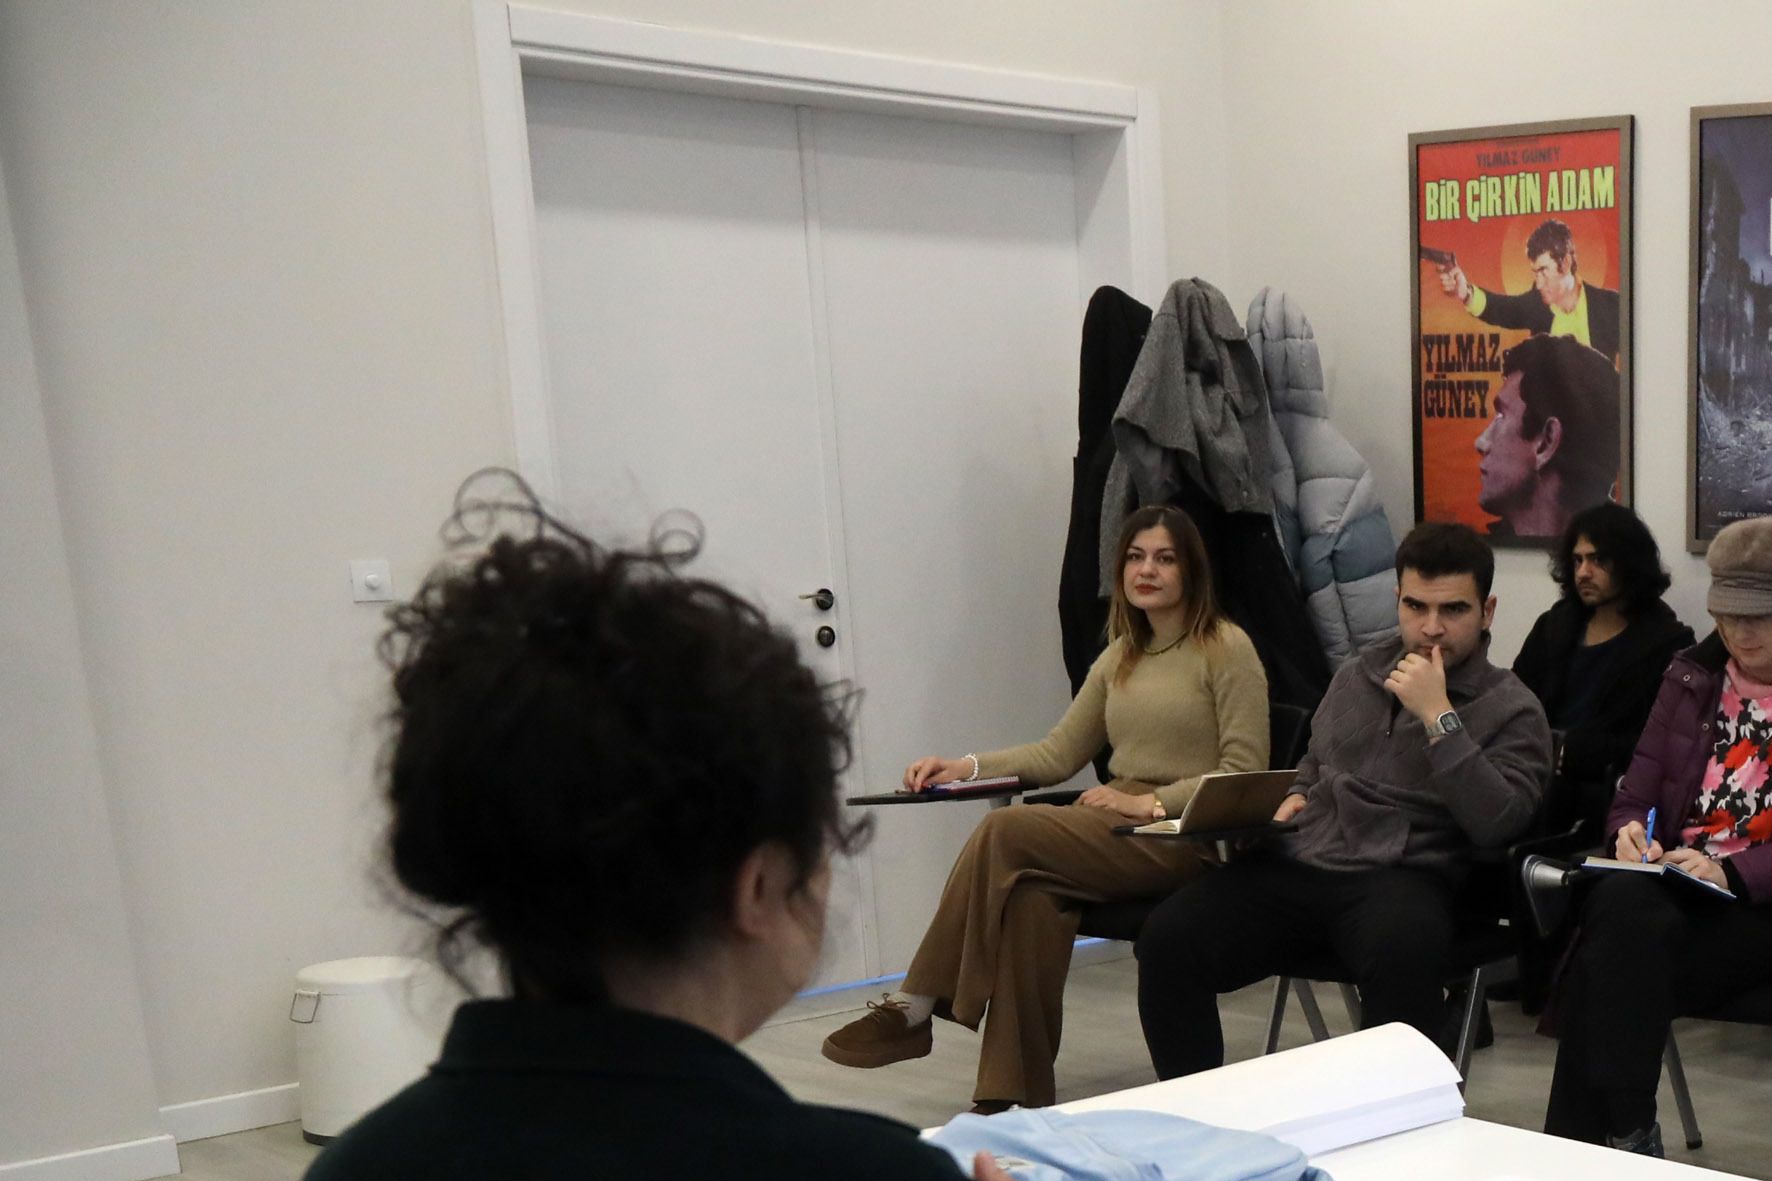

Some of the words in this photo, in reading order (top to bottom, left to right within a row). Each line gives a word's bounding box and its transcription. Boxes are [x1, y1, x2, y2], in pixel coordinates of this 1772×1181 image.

[1546, 166, 1615, 212] ADAM
[1422, 334, 1501, 372] YILMAZ
[1424, 374, 1489, 418] GÜNEY
